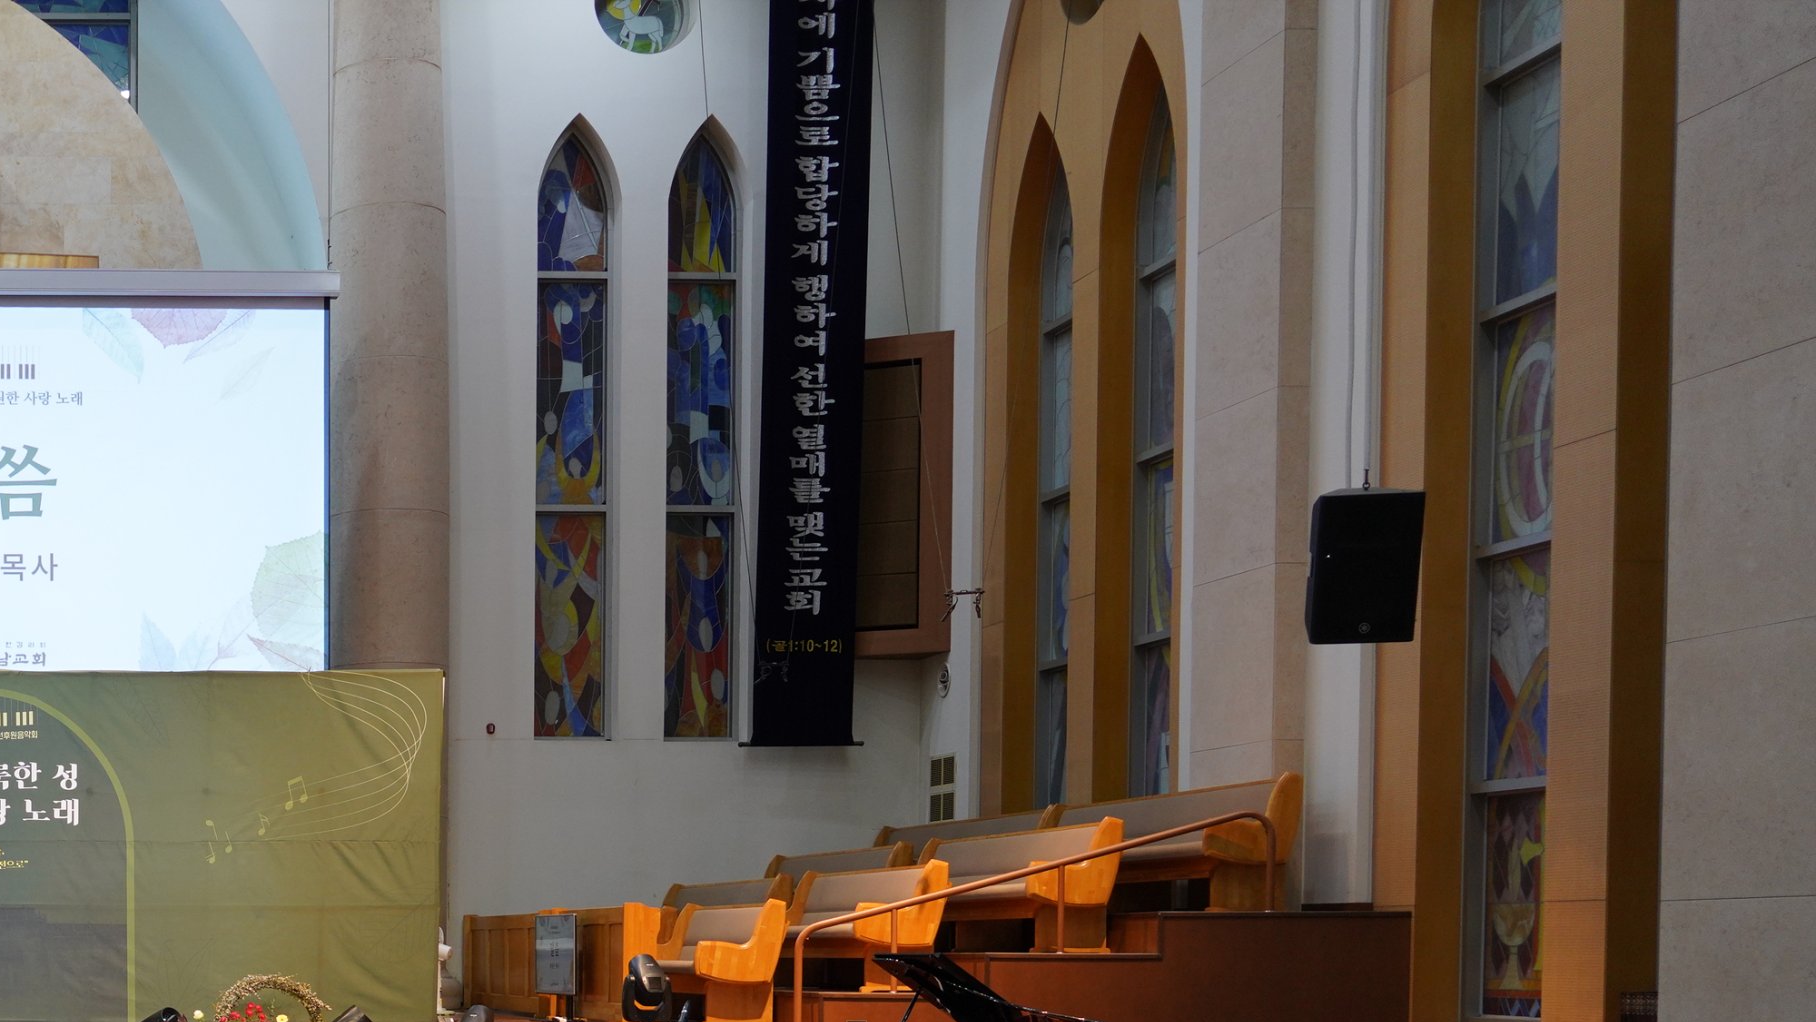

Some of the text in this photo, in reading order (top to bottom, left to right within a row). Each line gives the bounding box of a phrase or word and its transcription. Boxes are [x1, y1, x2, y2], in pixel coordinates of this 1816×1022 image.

[784, 0, 841, 616] 에 기쁨으로 합당하게 행하여 선한 열매를 맺는 교회
[24, 391, 51, 406] 사랑
[56, 391, 83, 406] 노래
[0, 552, 59, 582] 목사
[52, 763, 79, 791] 성
[22, 798, 80, 827] 노래
